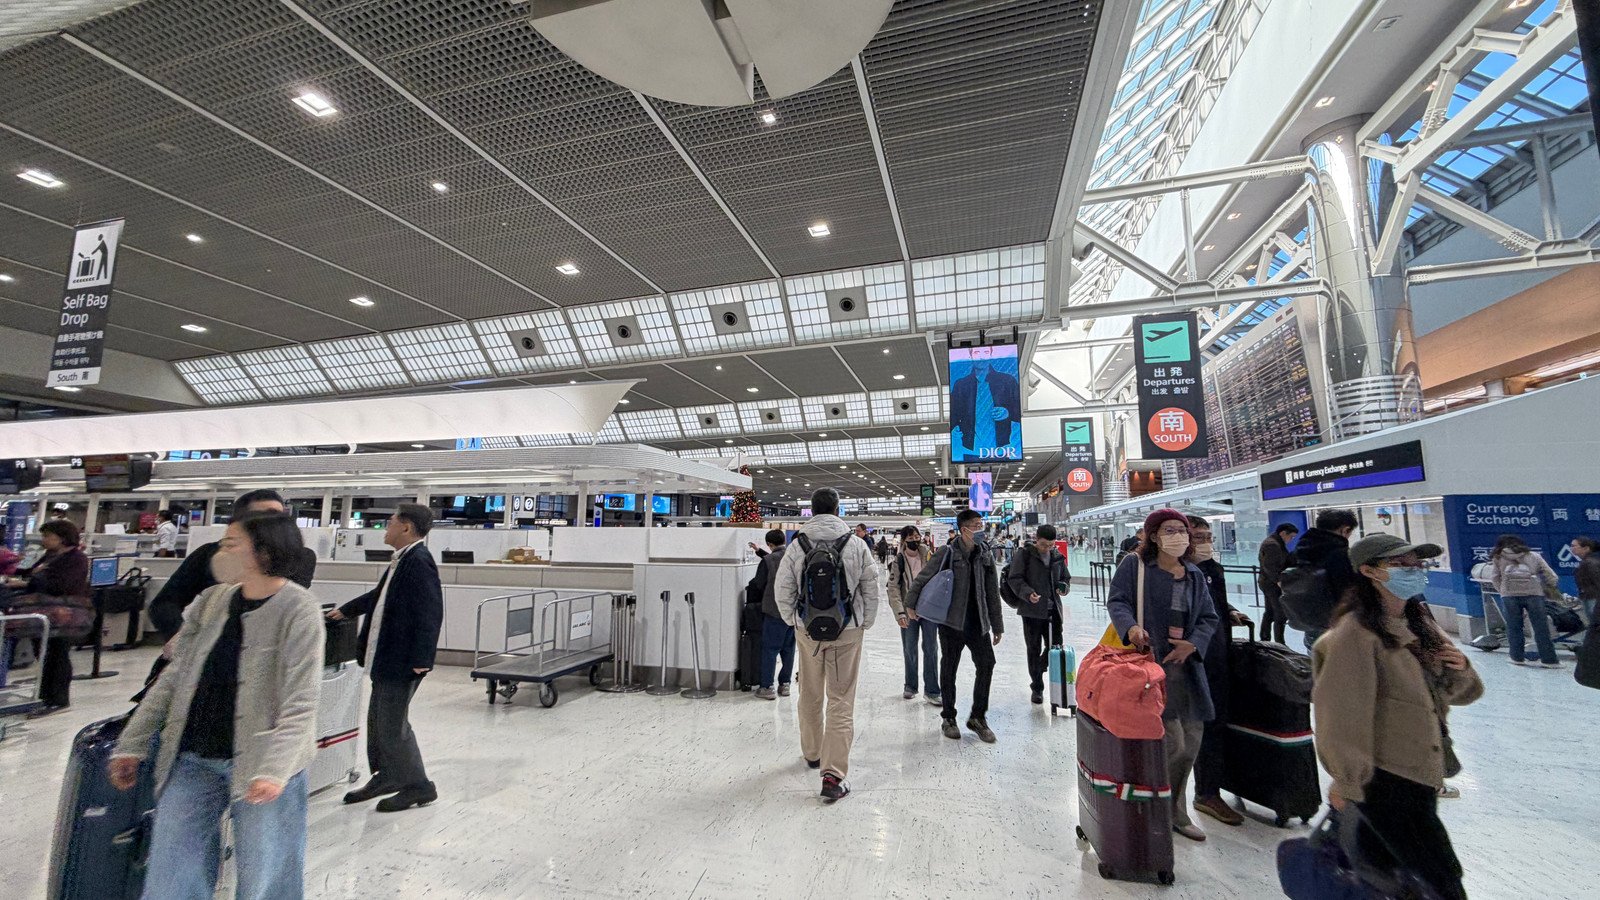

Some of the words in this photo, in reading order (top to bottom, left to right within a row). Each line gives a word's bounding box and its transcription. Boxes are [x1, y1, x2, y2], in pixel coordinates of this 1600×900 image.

[62, 293, 86, 310] Self
[86, 293, 109, 309] Bag
[60, 312, 89, 328] Drop
[57, 372, 78, 382] South
[1153, 366, 1183, 378] 出発
[1143, 377, 1196, 387] Departures
[1151, 387, 1168, 395] 出发
[1157, 410, 1185, 432] 南
[1154, 433, 1192, 443] SOUTH
[979, 446, 1017, 459] DIOR
[71, 458, 83, 467] P9
[1072, 470, 1087, 482] 南
[1305, 468, 1325, 478] Currency
[1324, 464, 1348, 474] Exchange
[595, 494, 604, 503] M
[1466, 503, 1535, 515] Currency
[1466, 514, 1539, 527] Exchange
